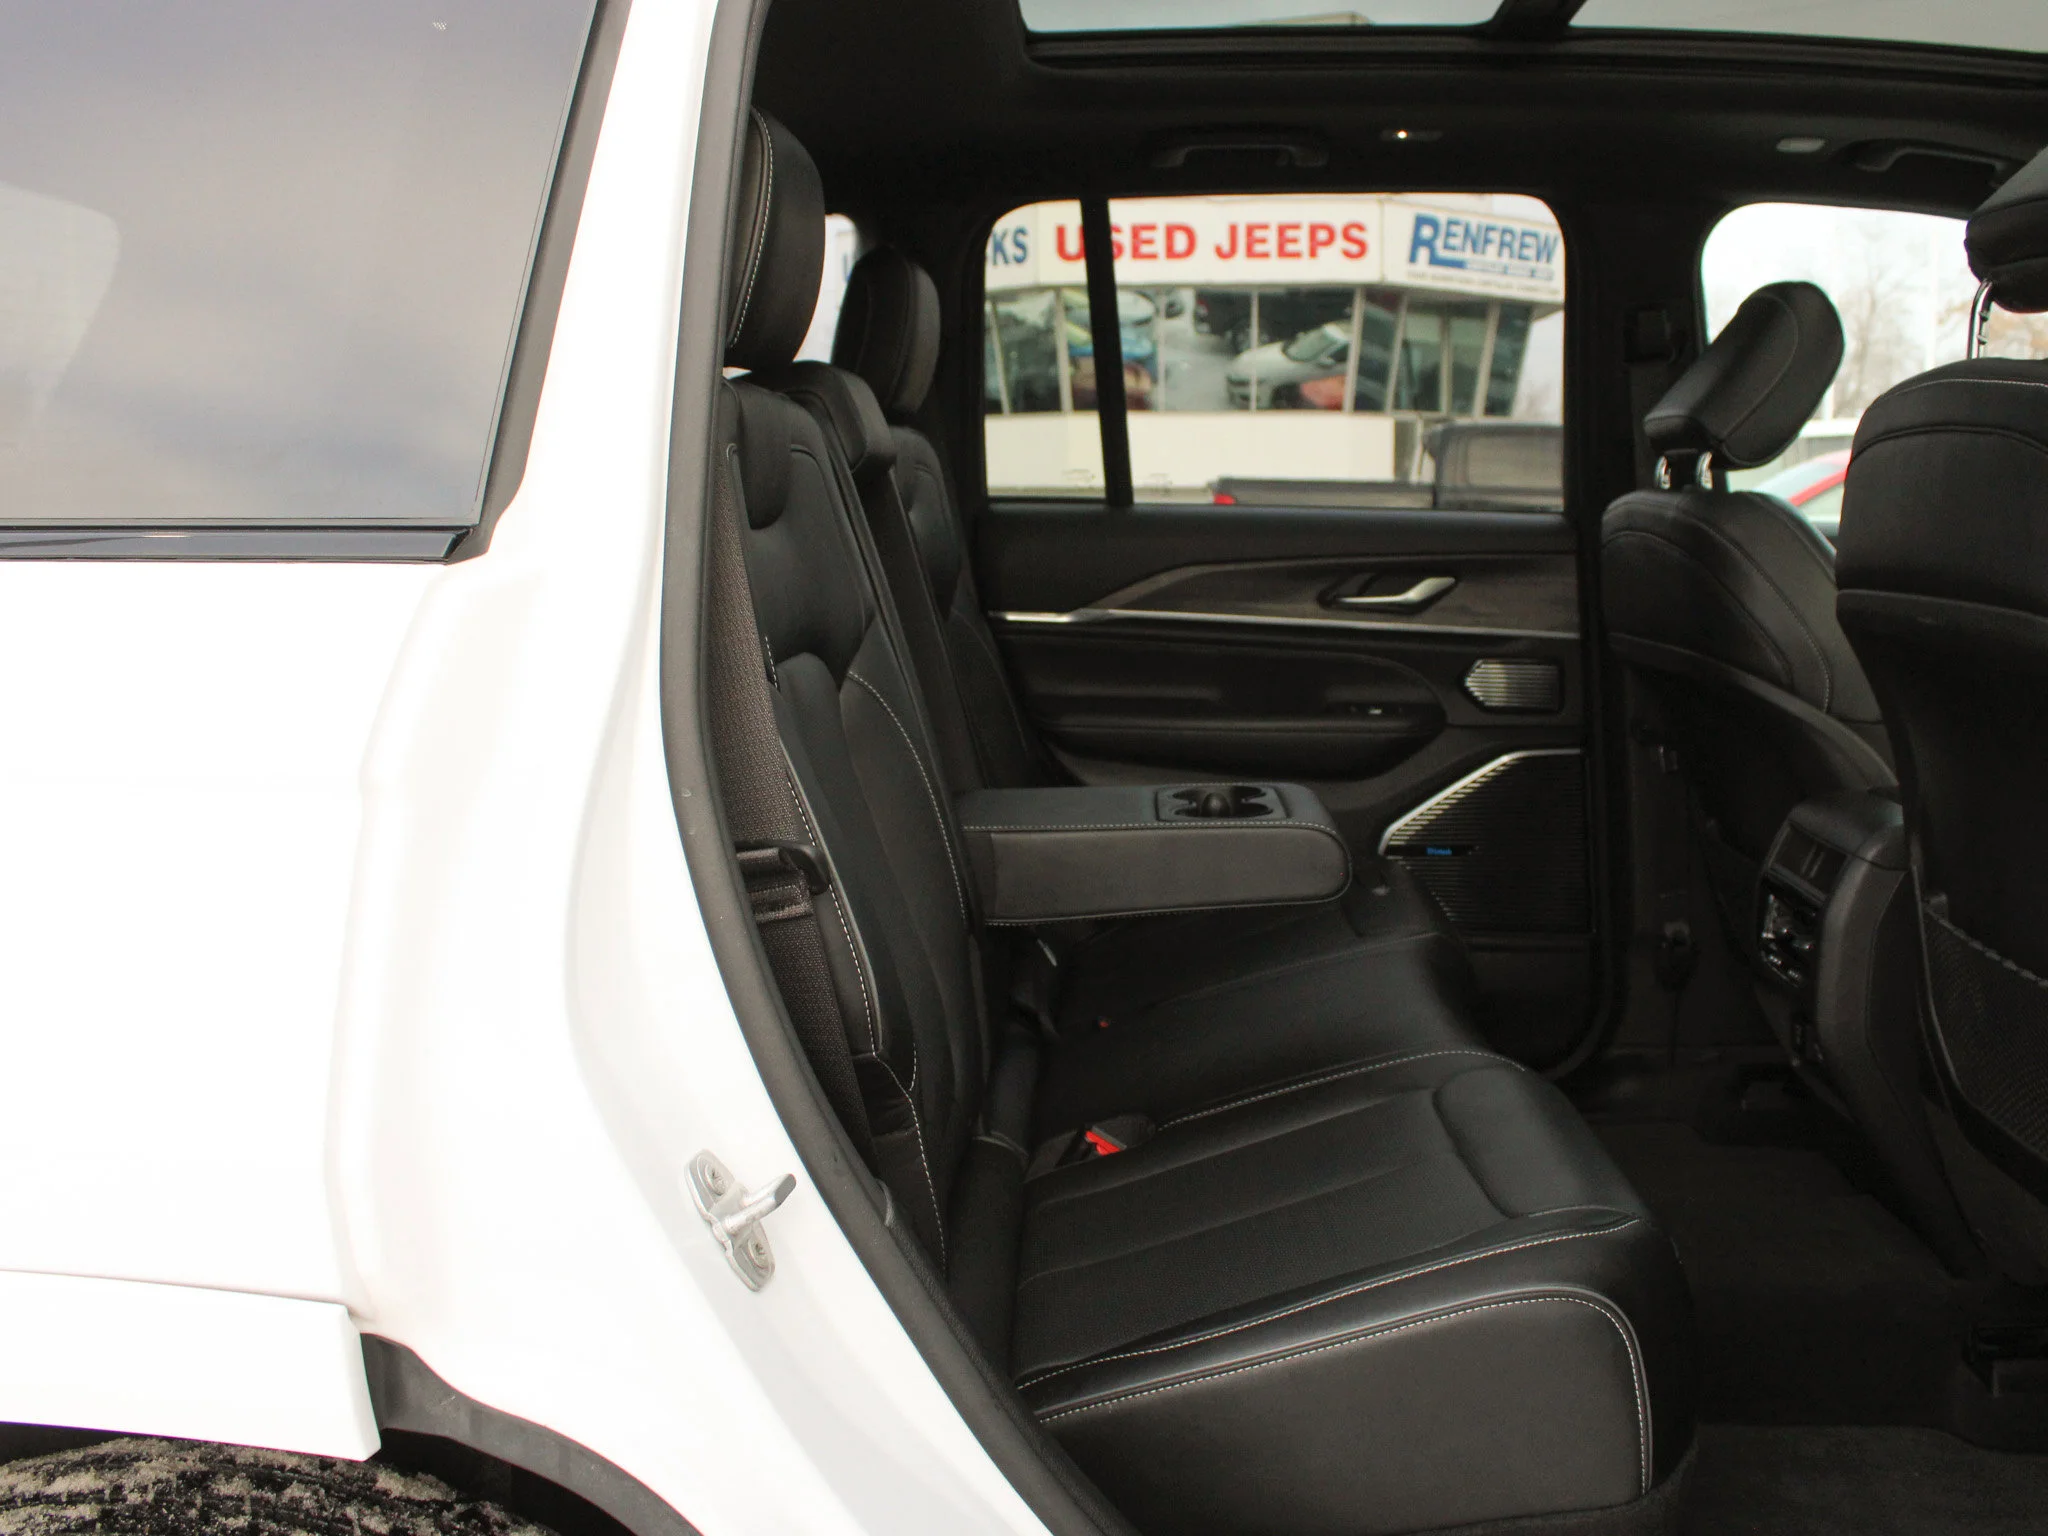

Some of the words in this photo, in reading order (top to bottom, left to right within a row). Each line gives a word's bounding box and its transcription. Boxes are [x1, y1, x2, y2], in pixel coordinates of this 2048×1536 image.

[991, 226, 1027, 265] KS
[1215, 222, 1368, 260] JEEPS
[1409, 212, 1560, 268] RENFREW
